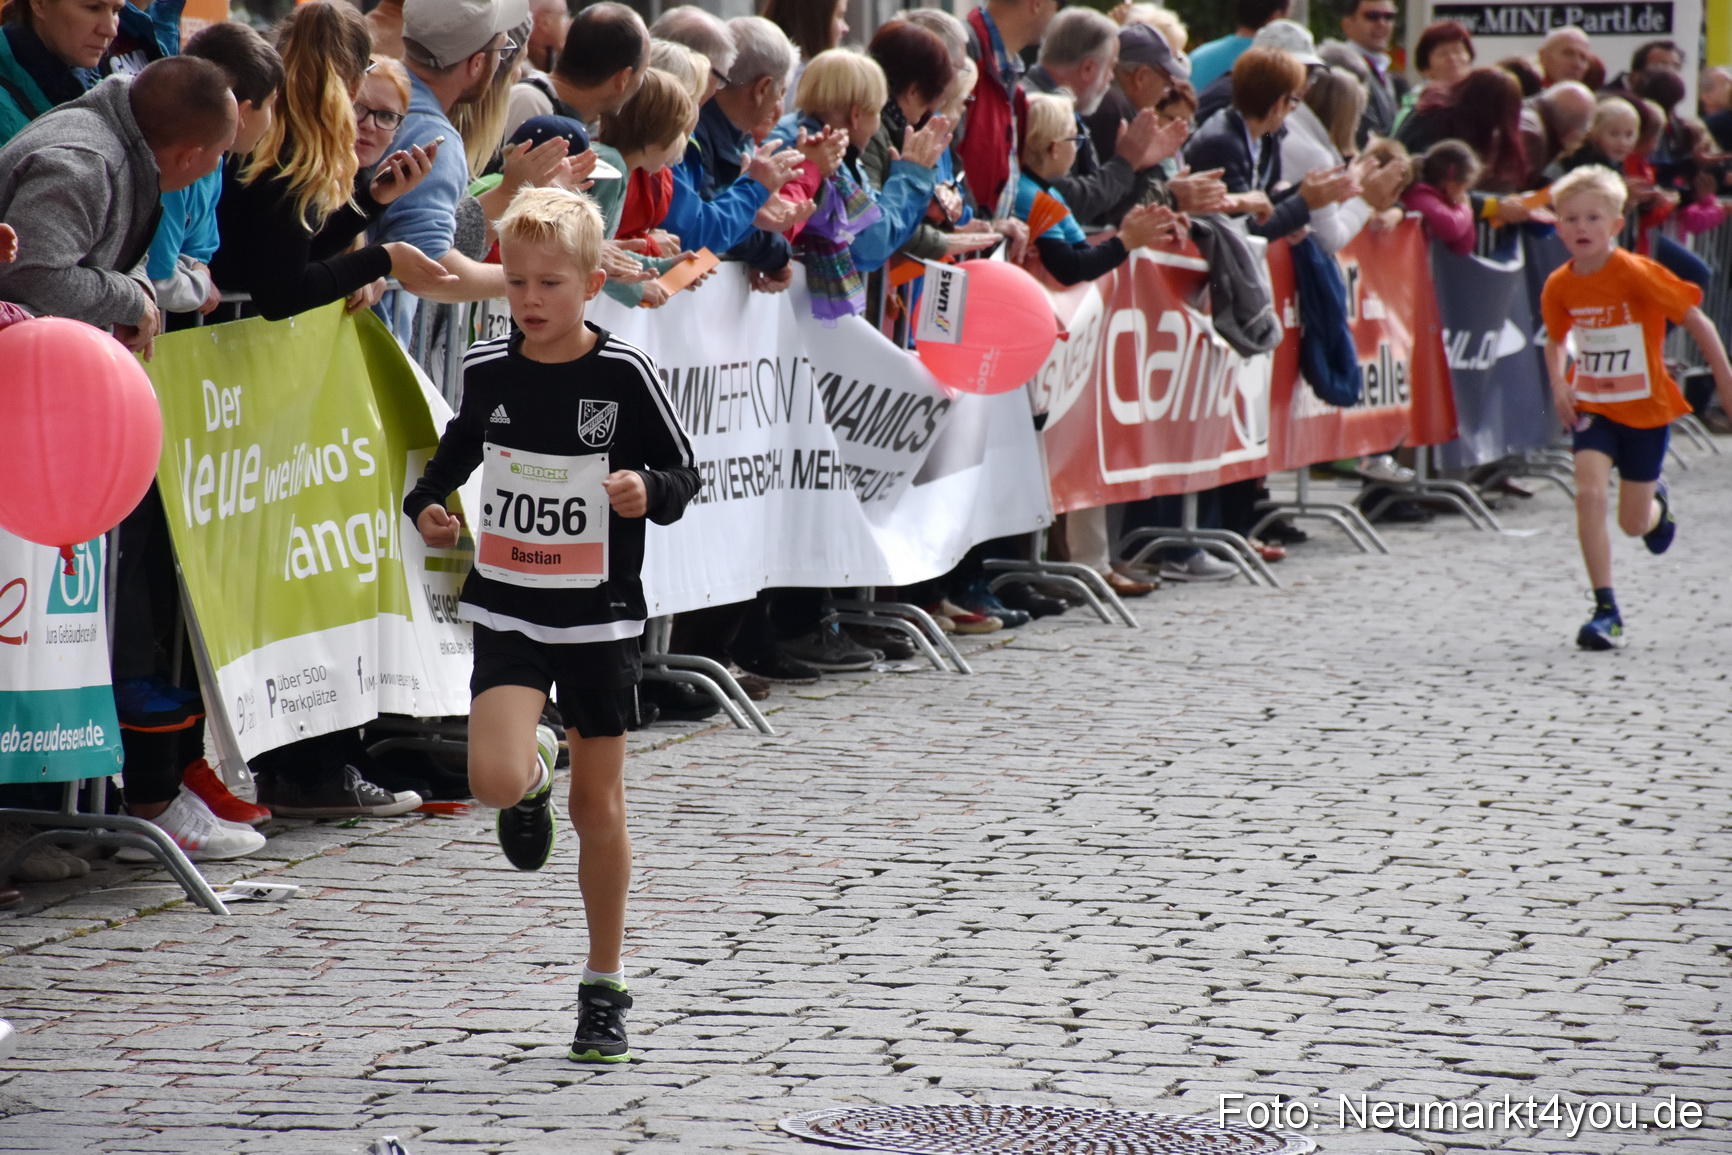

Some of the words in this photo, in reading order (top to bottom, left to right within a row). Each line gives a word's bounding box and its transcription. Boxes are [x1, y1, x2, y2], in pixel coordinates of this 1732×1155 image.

[202, 379, 242, 432] Der
[489, 416, 511, 424] adidas
[589, 411, 615, 444] TSV
[523, 464, 568, 479] BOCK
[496, 488, 587, 537] 7056
[511, 546, 562, 565] Bastian
[277, 673, 302, 692] über
[303, 665, 328, 685] 500
[281, 689, 338, 715] Parkplätze
